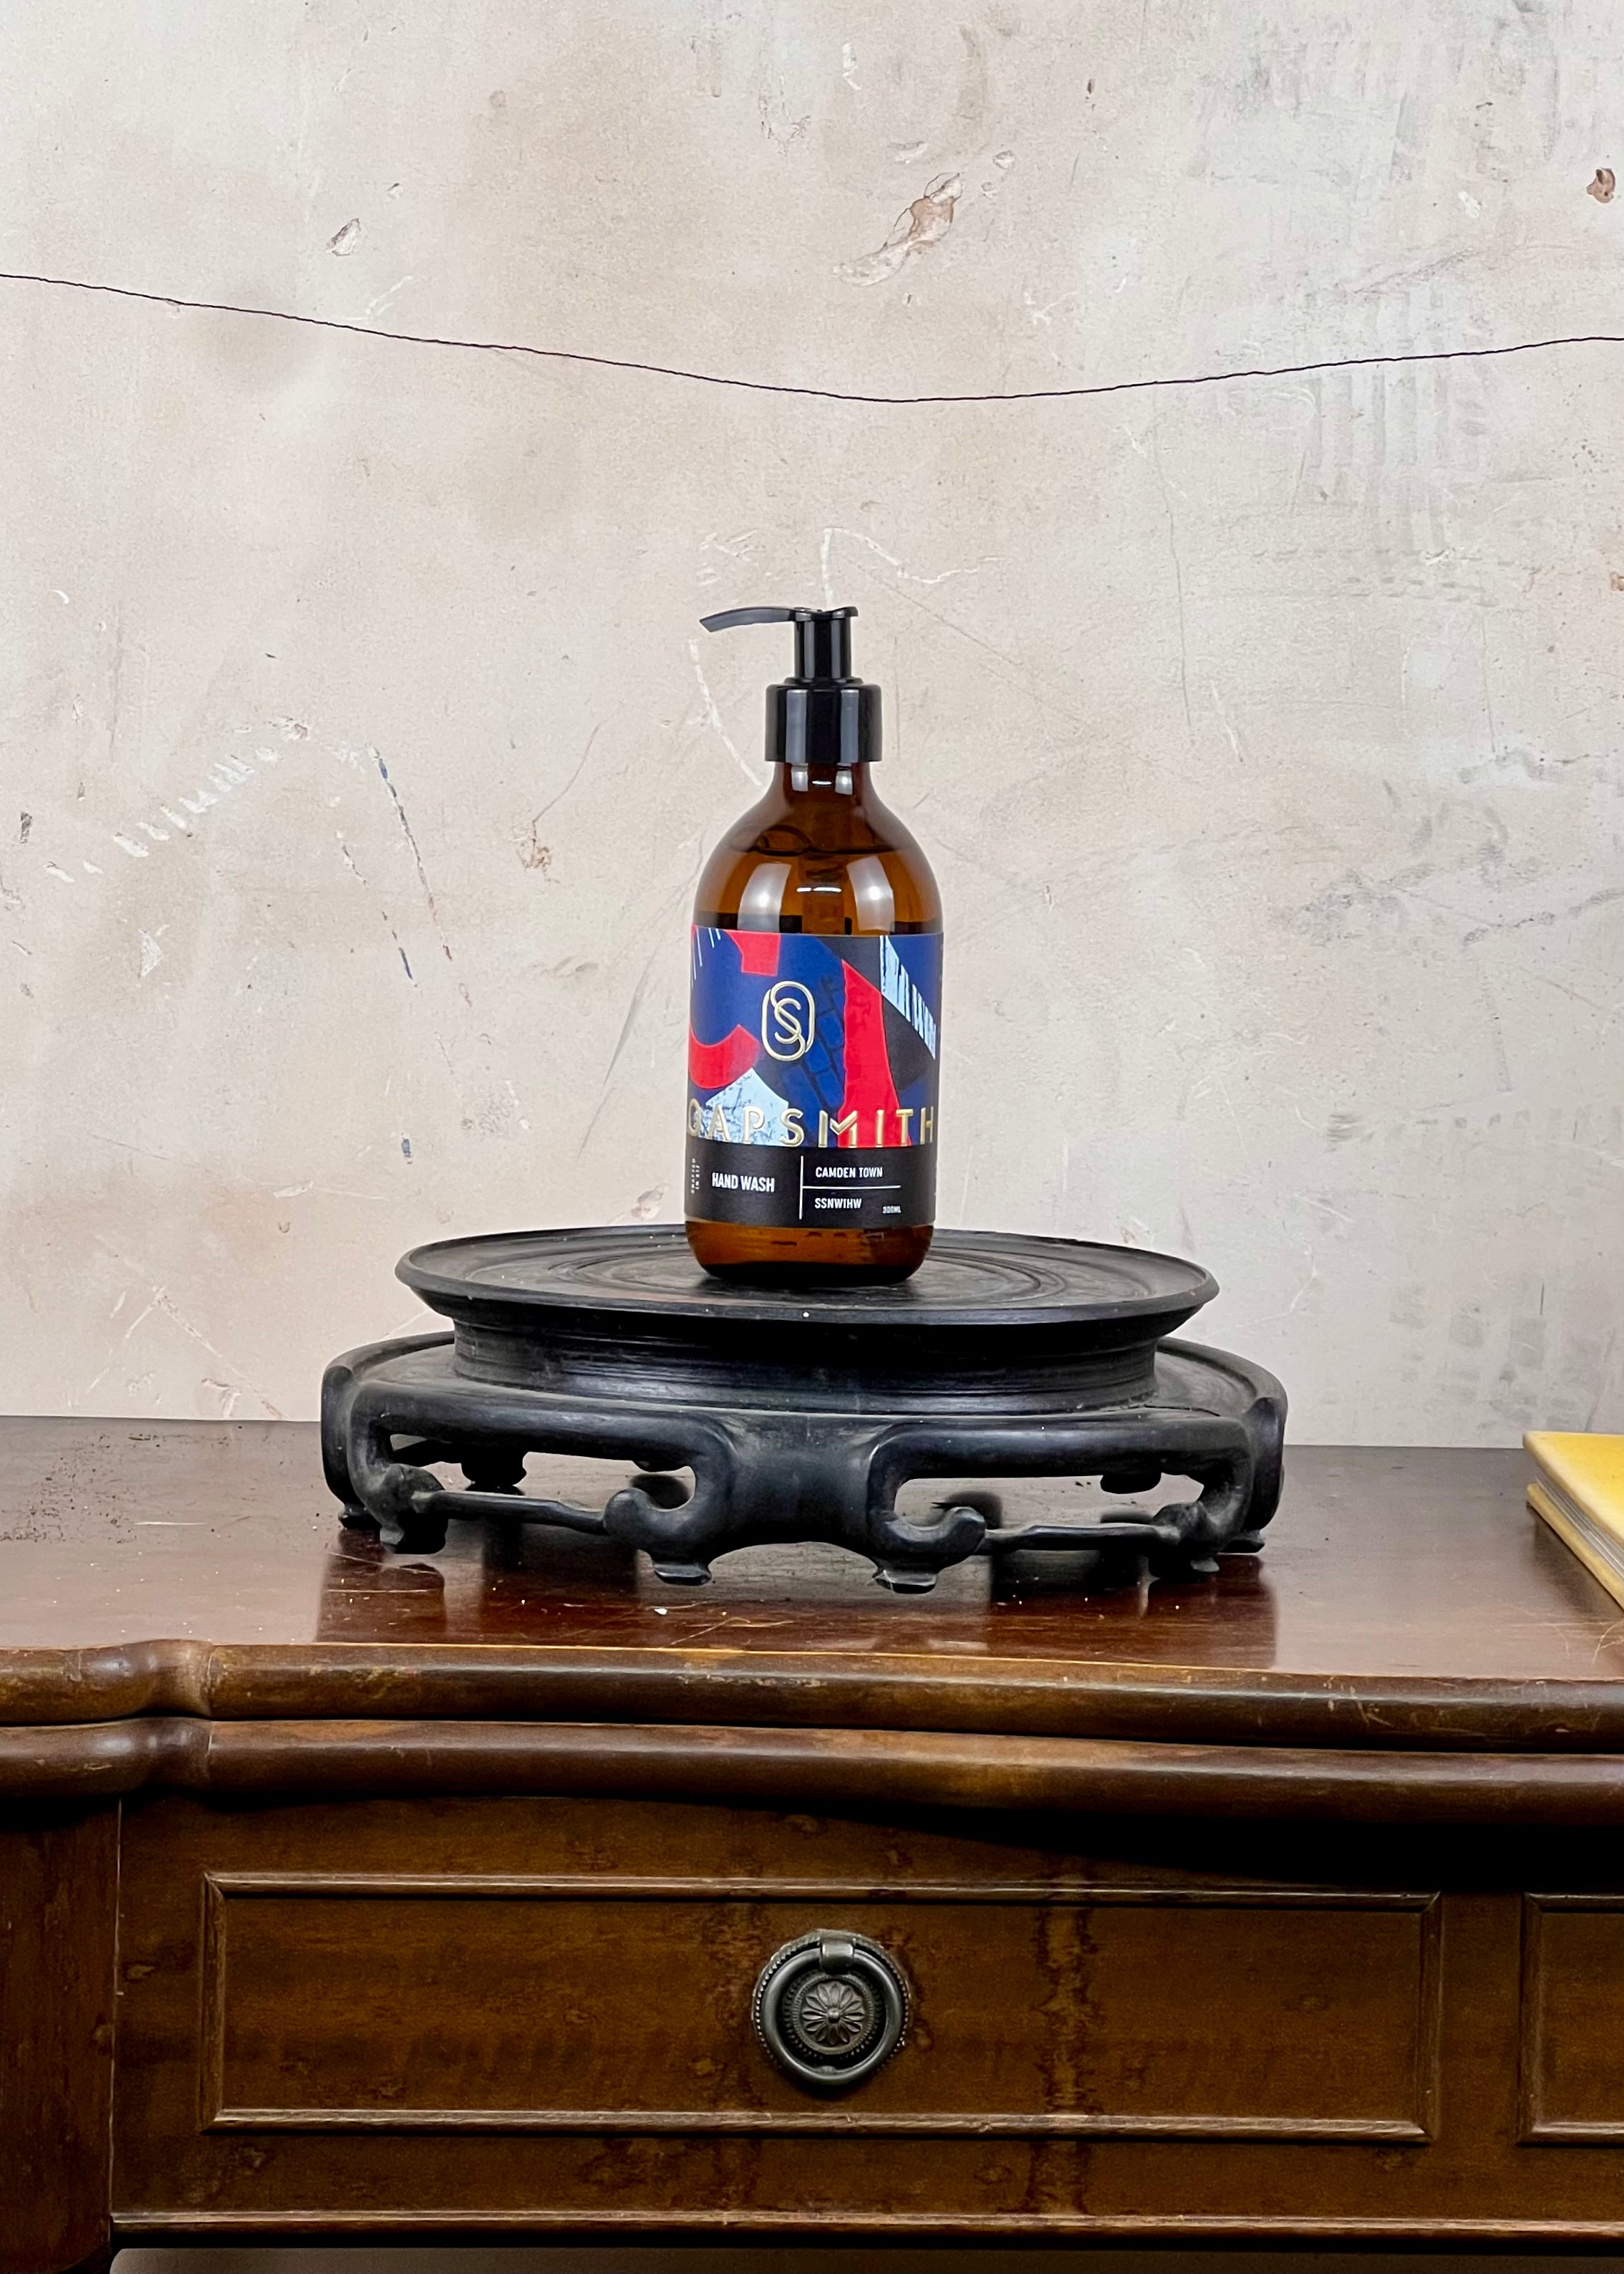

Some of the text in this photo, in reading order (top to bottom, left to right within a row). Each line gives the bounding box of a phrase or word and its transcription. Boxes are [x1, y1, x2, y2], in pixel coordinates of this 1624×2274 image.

[816, 1167, 883, 1178] CAMDEN TOWN
[712, 1172, 775, 1193] HAND WASH
